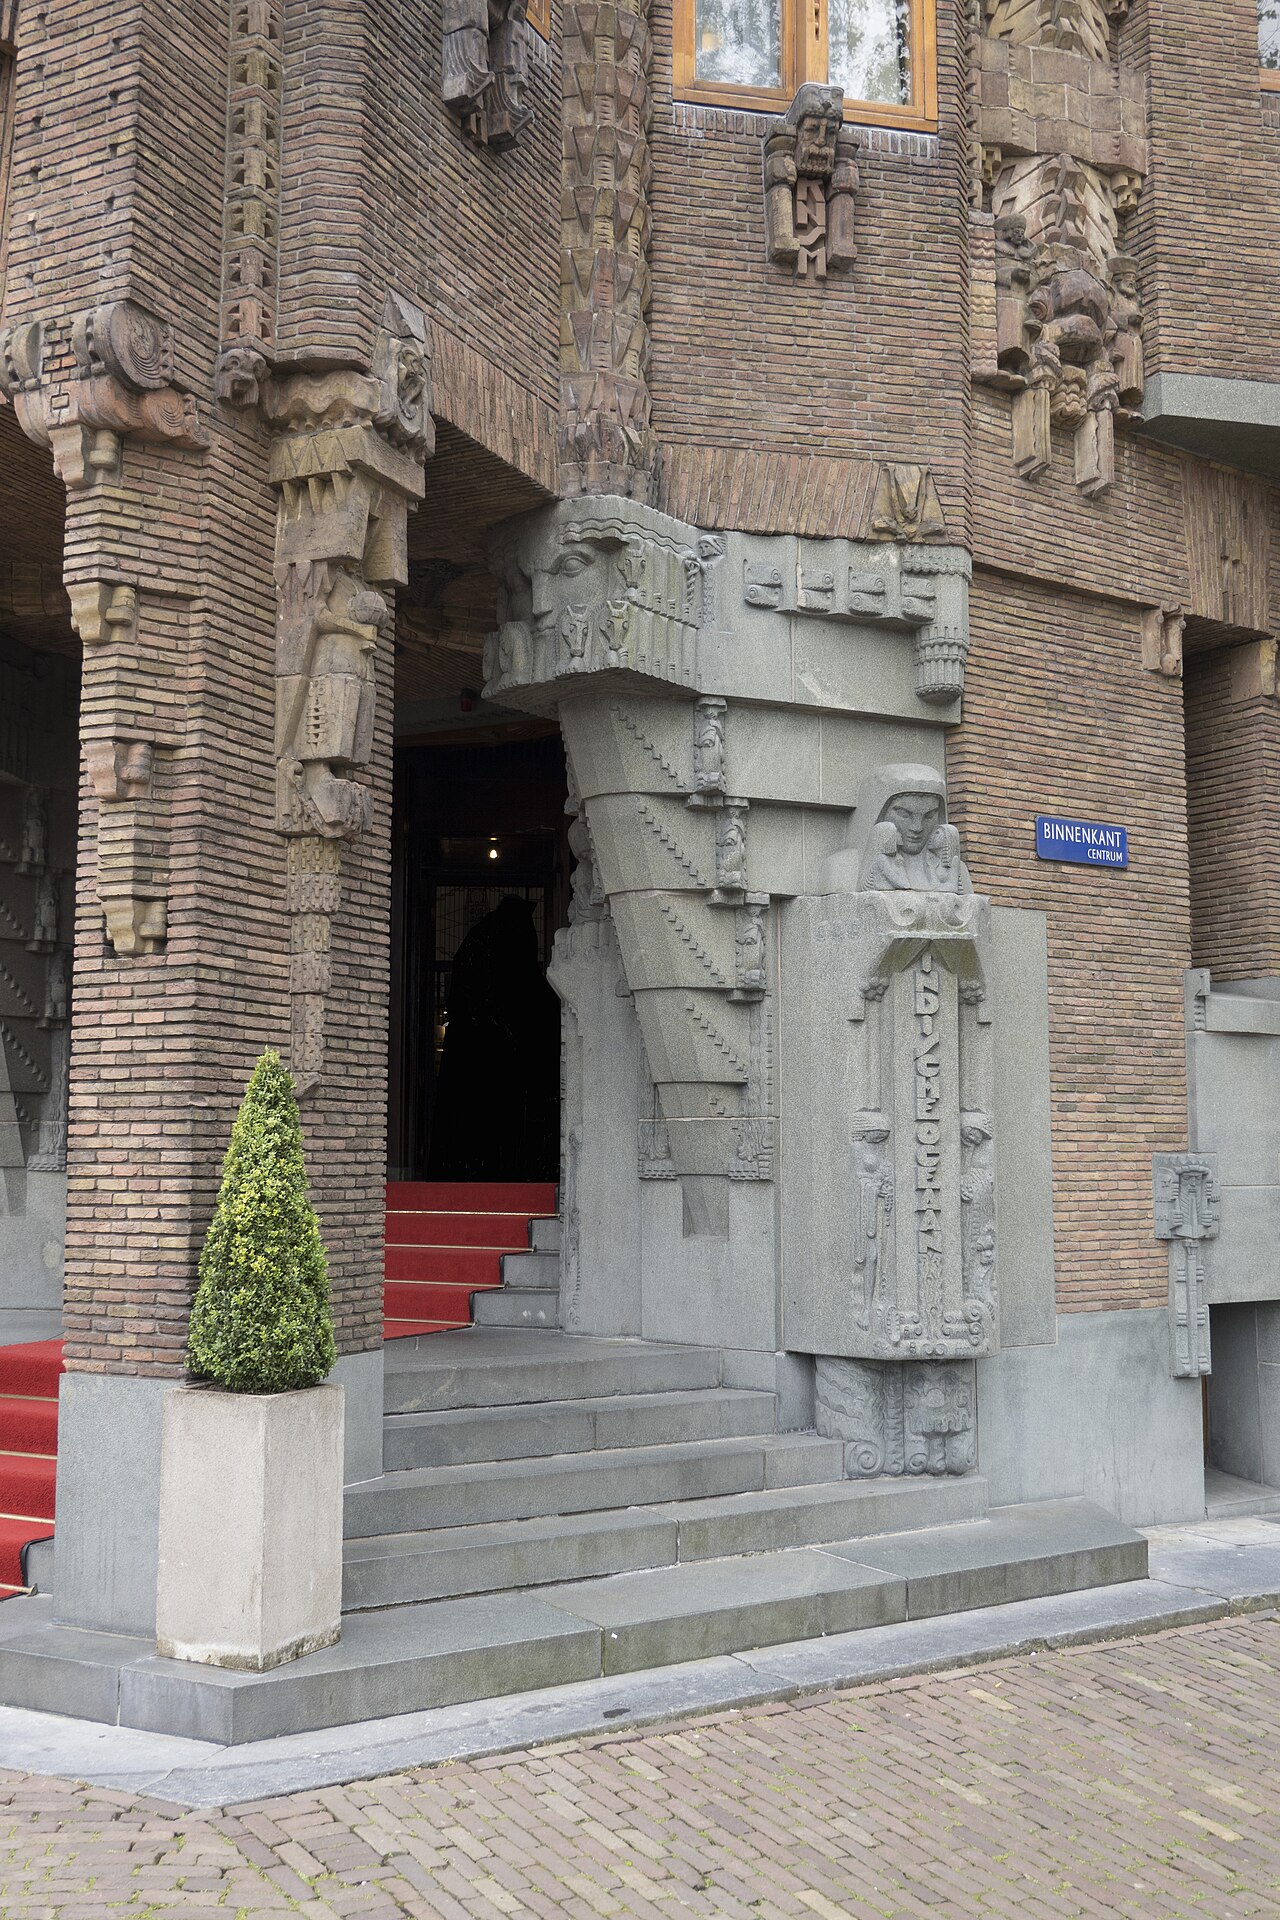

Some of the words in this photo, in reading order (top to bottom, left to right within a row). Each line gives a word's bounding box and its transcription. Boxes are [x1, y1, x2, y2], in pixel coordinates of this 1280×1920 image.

[1043, 822, 1121, 848] BINNENKANT
[1087, 848, 1123, 863] CENTRUM
[915, 1122, 942, 1254] OCEAAN
